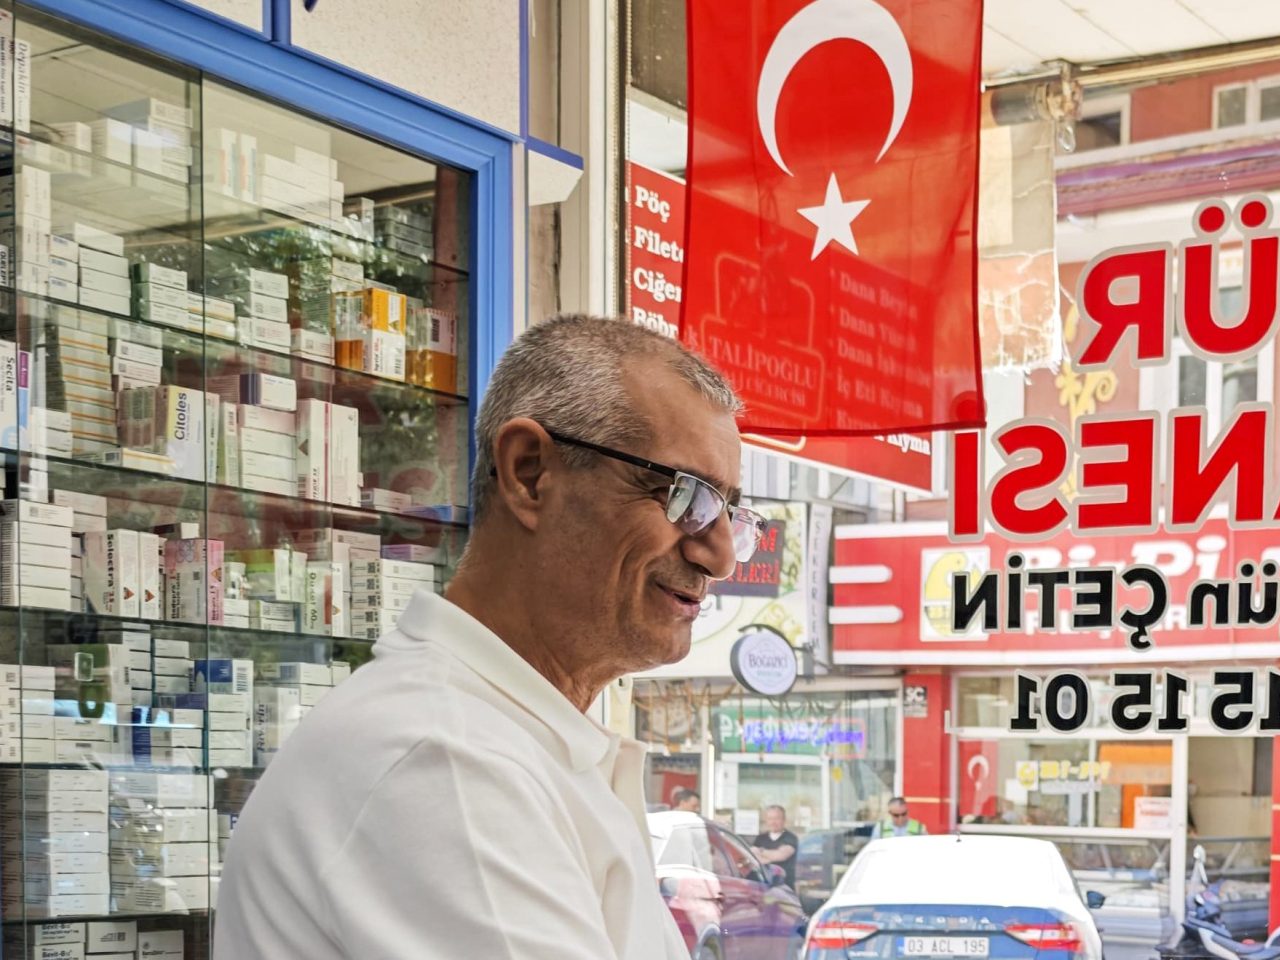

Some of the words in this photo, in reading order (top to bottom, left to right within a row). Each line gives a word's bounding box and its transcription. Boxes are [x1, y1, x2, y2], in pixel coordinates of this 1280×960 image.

[634, 185, 670, 223] Pöç
[174, 392, 187, 440] Citoles
[908, 940, 924, 953] 03
[931, 940, 954, 953] ACL
[964, 940, 986, 953] 195
